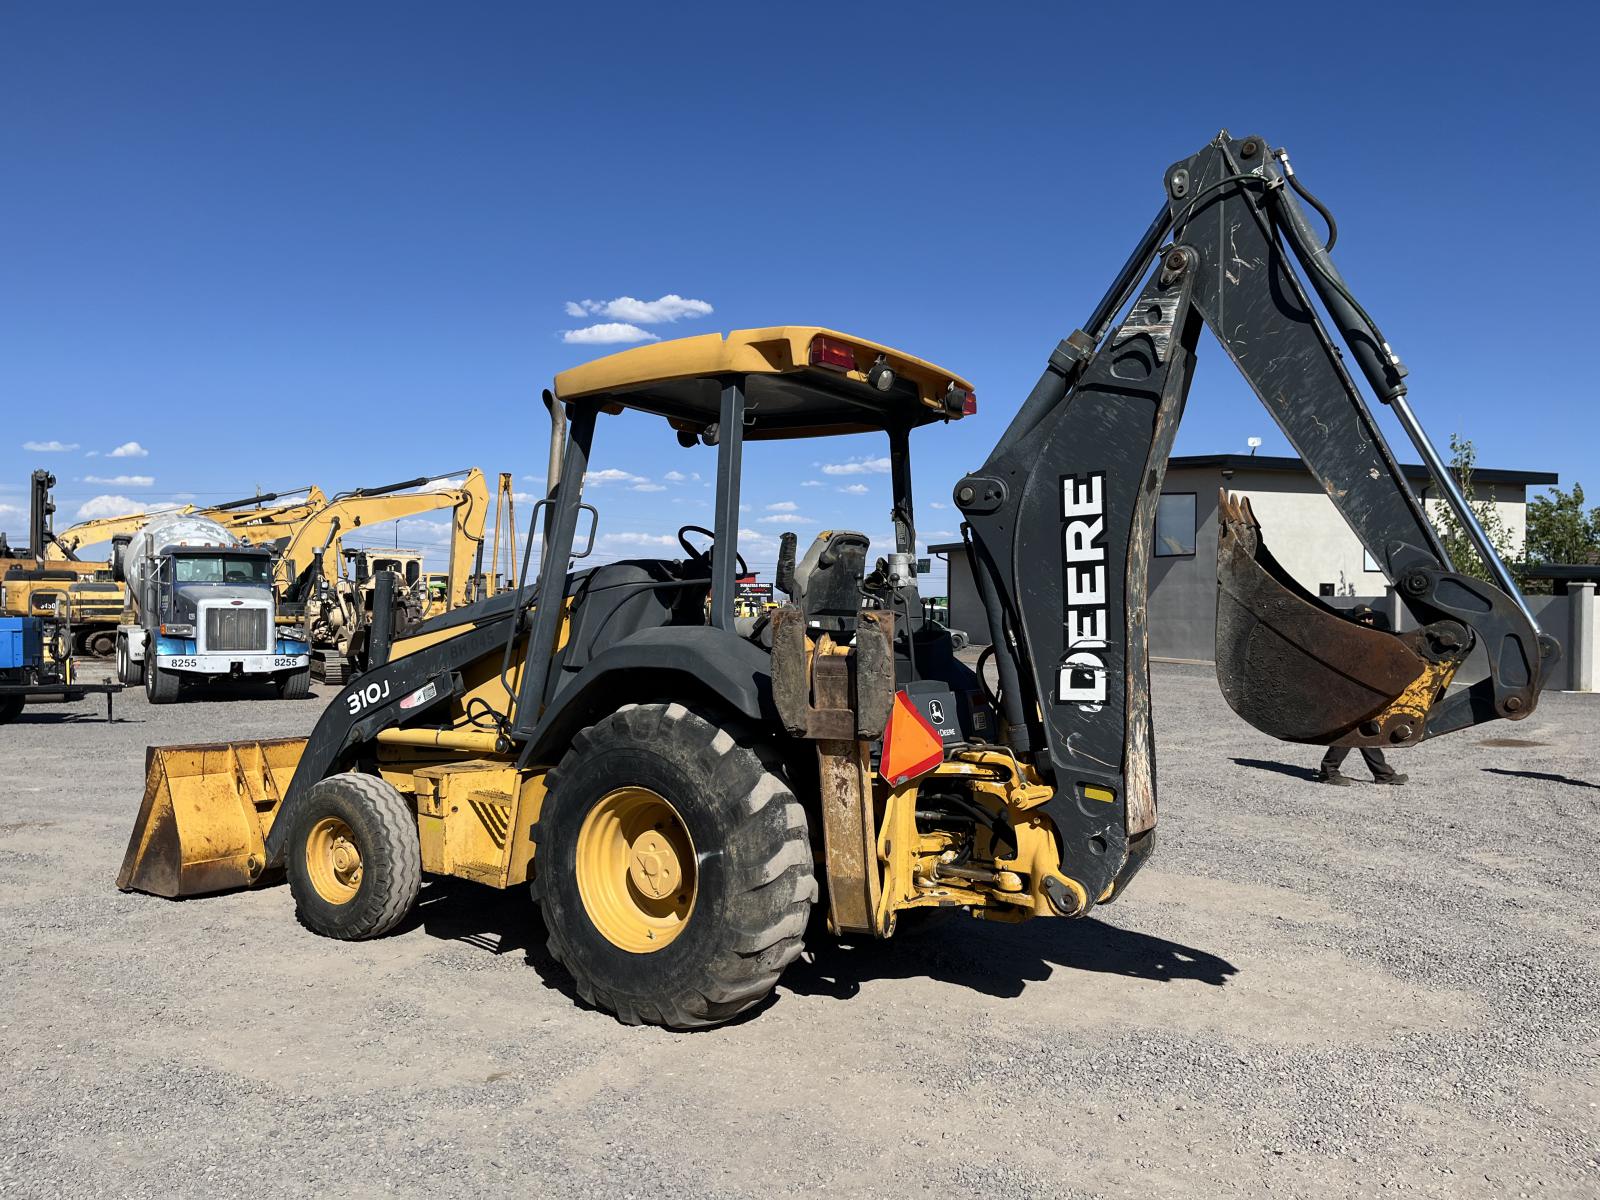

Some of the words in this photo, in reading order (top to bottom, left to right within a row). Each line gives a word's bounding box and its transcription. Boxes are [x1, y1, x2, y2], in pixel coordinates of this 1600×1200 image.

[1059, 475, 1106, 701] DEERE
[171, 658, 197, 668] 8255
[274, 658, 298, 667] 8255
[346, 679, 390, 715] 310J
[940, 728, 956, 736] DEERE
